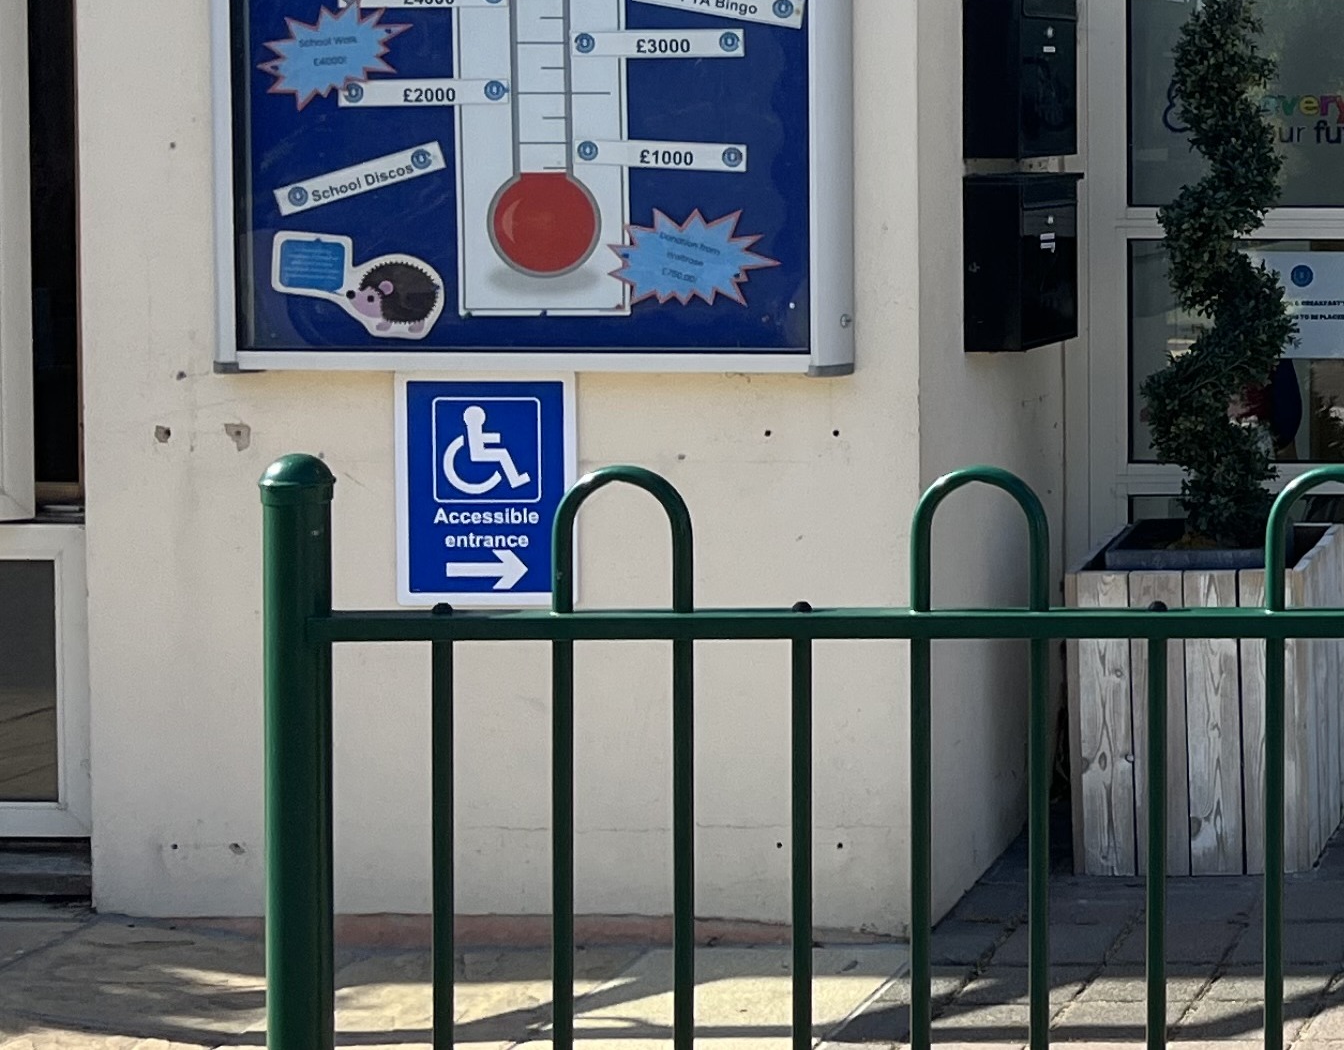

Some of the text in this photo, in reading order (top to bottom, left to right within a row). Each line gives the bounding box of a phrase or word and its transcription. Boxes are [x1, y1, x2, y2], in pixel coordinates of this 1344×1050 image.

[299, 37, 331, 48] School
[636, 38, 691, 56] £3000
[403, 87, 457, 105] £2000
[1277, 124, 1306, 144] ur
[639, 149, 695, 167] £1000
[312, 164, 414, 203] School Discos
[433, 507, 540, 524] Accessible
[445, 532, 529, 548] entrance
